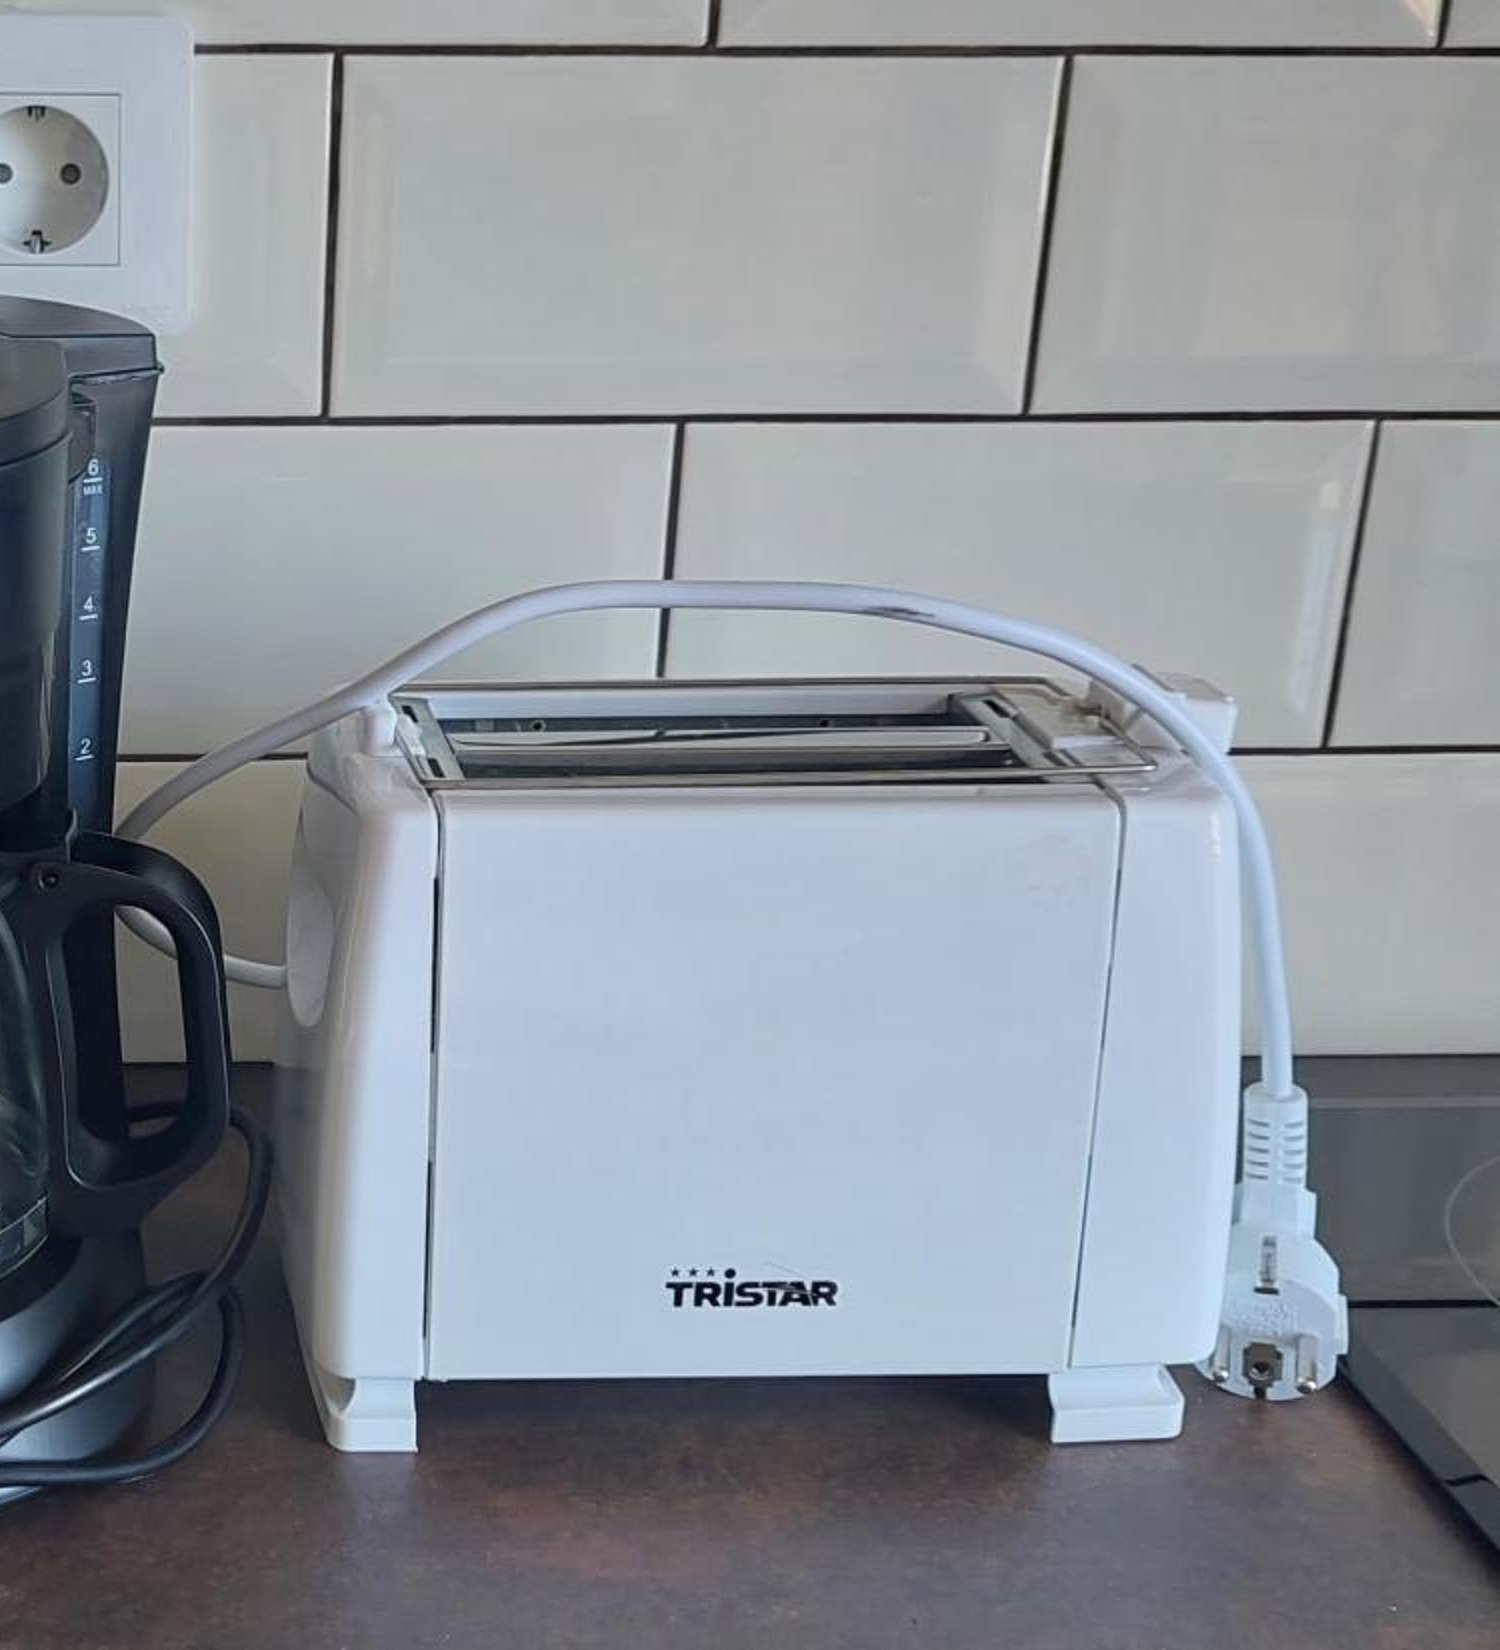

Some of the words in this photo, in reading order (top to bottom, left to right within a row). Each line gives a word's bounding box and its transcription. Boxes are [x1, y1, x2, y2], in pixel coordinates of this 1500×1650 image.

[86, 458, 100, 477] 6
[85, 526, 98, 545] 5
[82, 594, 95, 612] 4
[80, 658, 93, 677] 3
[79, 737, 92, 755] 2
